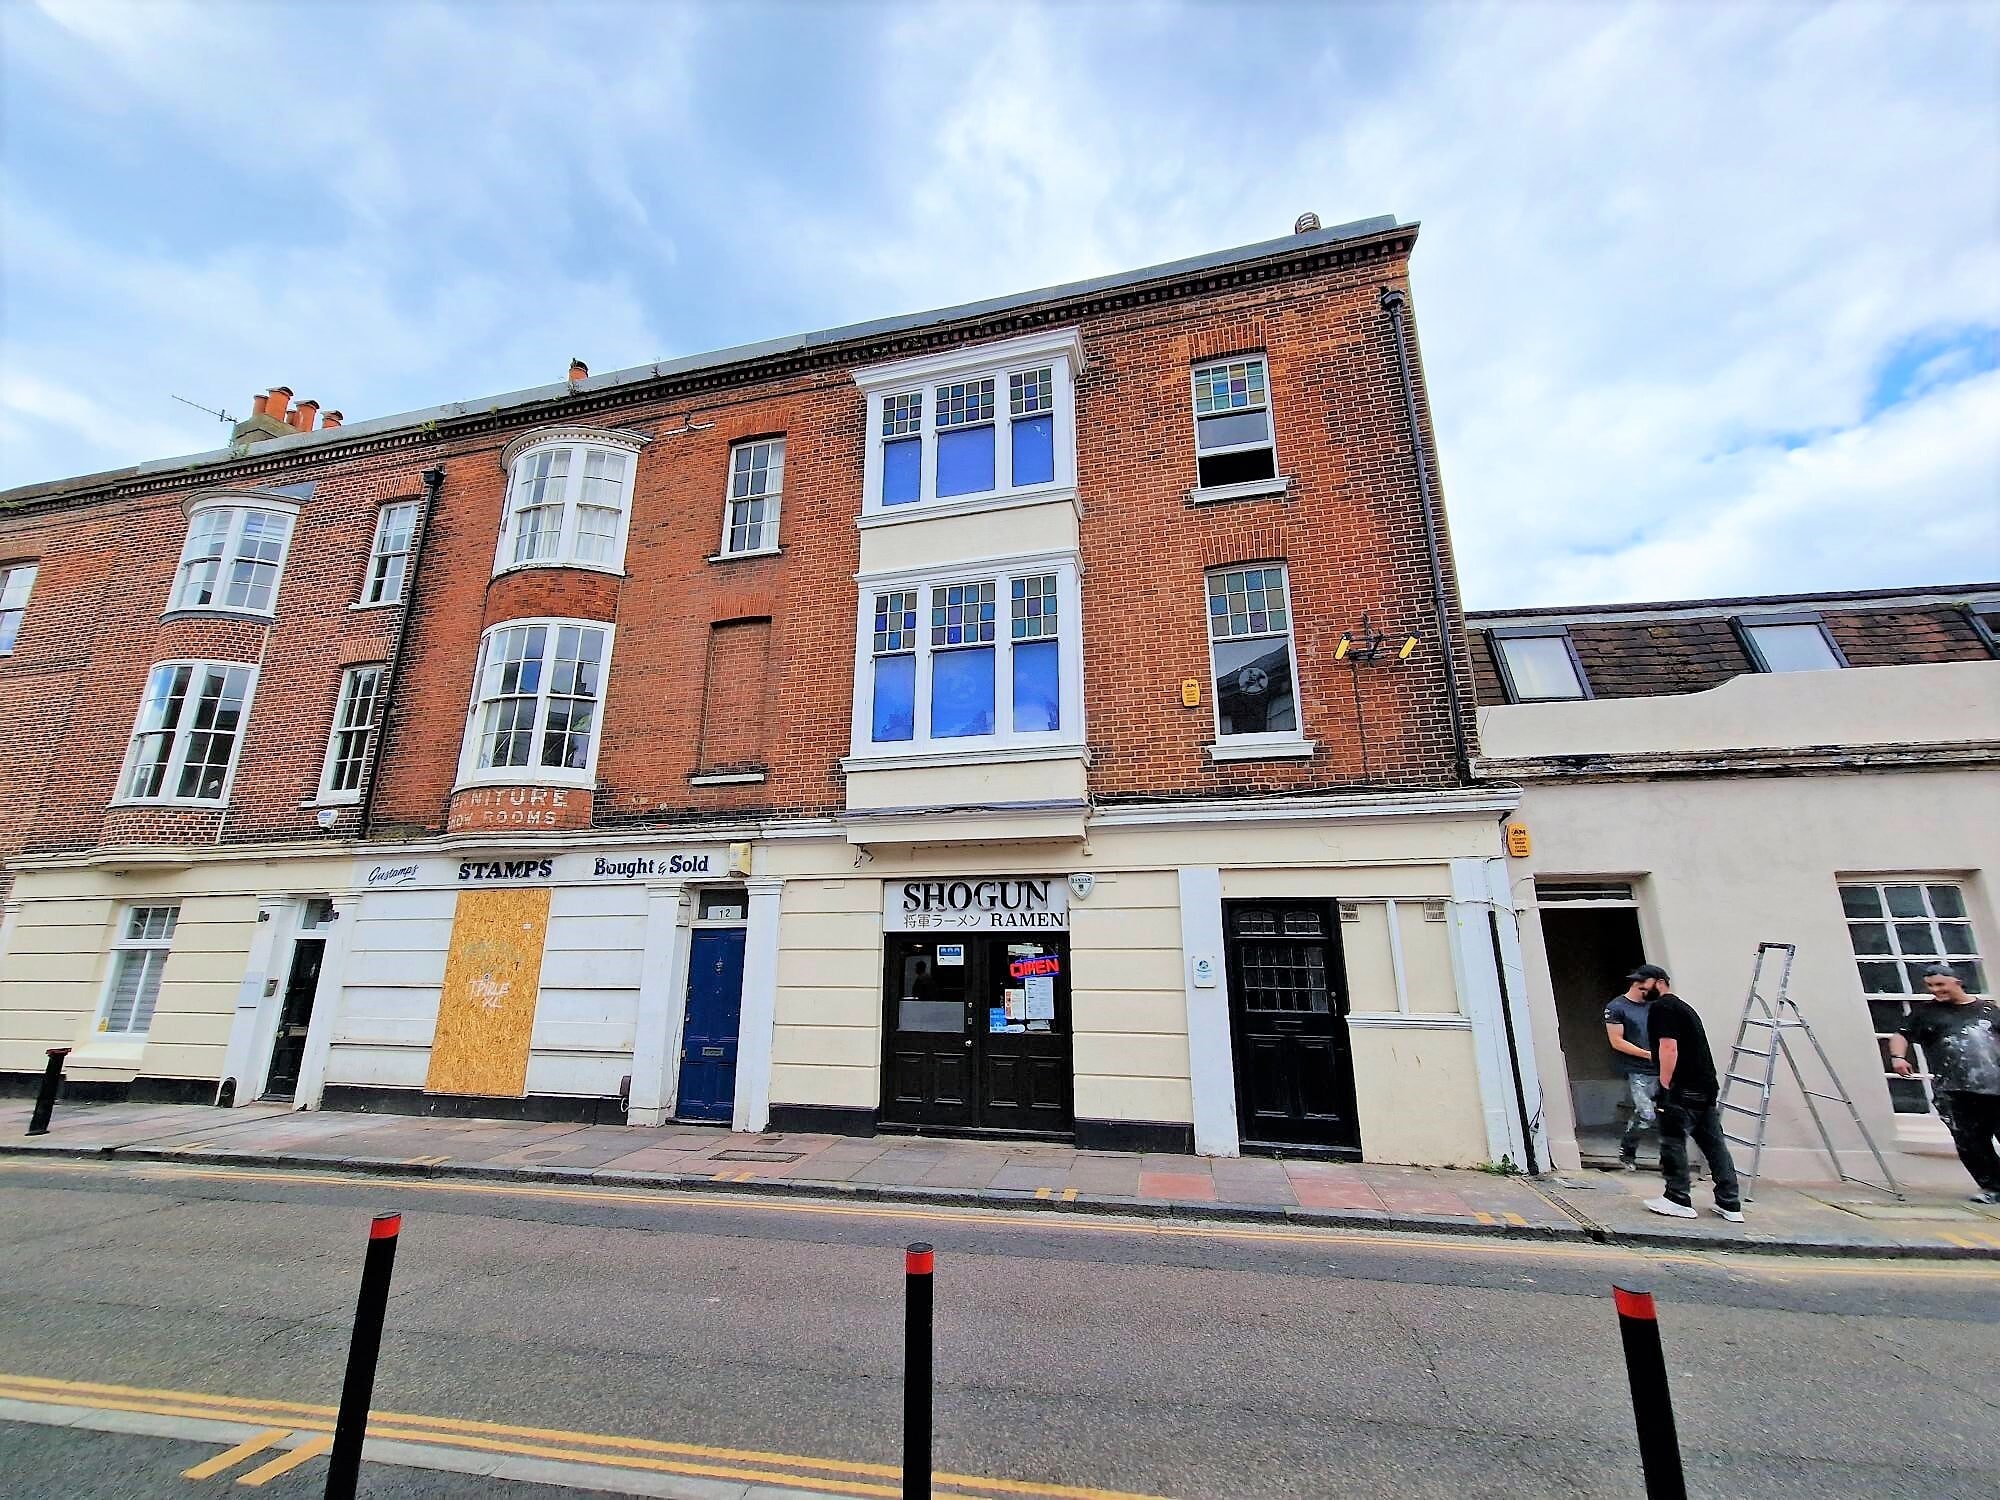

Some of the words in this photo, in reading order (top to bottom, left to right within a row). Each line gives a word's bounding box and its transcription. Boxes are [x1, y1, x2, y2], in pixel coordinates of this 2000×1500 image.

[450, 787, 569, 808] URNITURE
[482, 810, 558, 825] ROOMS
[458, 859, 553, 881] STAMPS
[593, 857, 655, 879] Bought
[657, 861, 667, 875] &
[669, 854, 709, 873] Sold
[903, 880, 1051, 912] SHOGUN
[719, 908, 731, 918] 12
[903, 913, 982, 928] 将軍ラーメン
[989, 912, 1065, 928] RAMEN
[1009, 958, 1060, 977] OPEN
